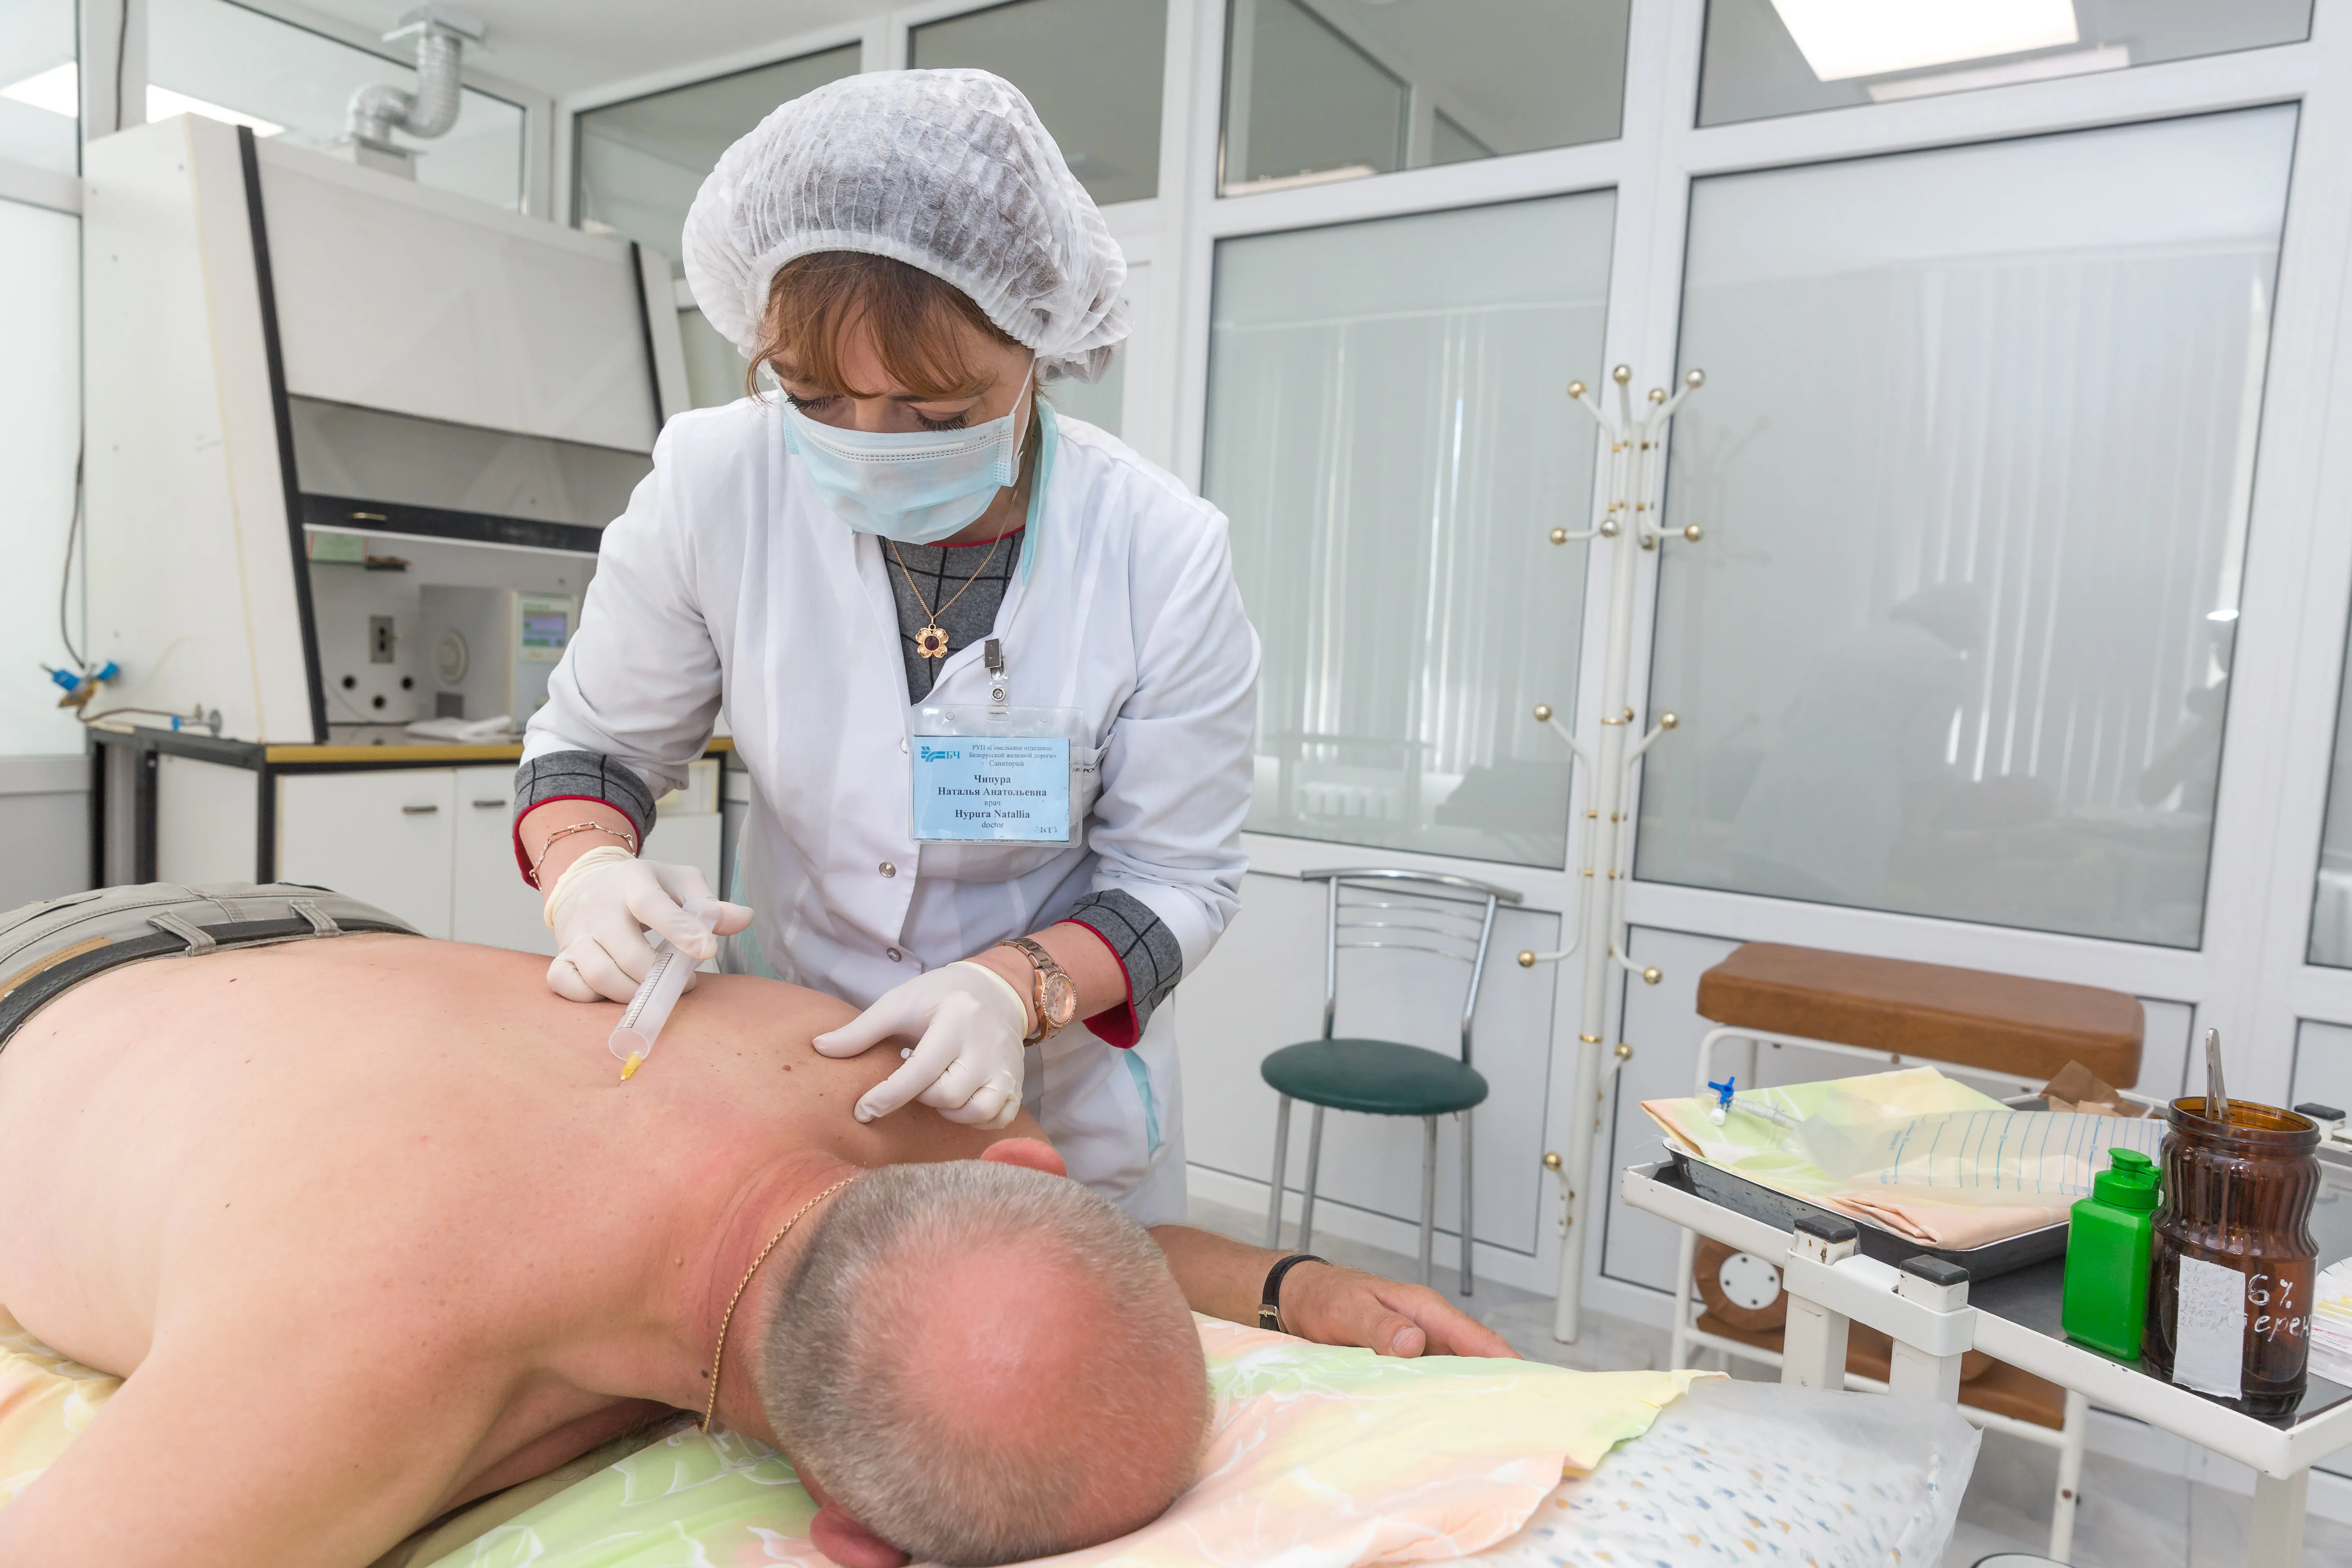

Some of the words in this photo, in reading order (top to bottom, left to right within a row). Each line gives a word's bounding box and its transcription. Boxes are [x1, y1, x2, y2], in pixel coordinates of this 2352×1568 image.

[946, 751, 960, 759] БЧ
[973, 775, 1011, 785] Чипура
[938, 787, 980, 795] Наталья
[983, 788, 1047, 796] Анатольевна
[955, 809, 991, 820] Hypura
[994, 810, 1030, 818] Natallia
[2248, 1274, 2293, 1309] 6%
